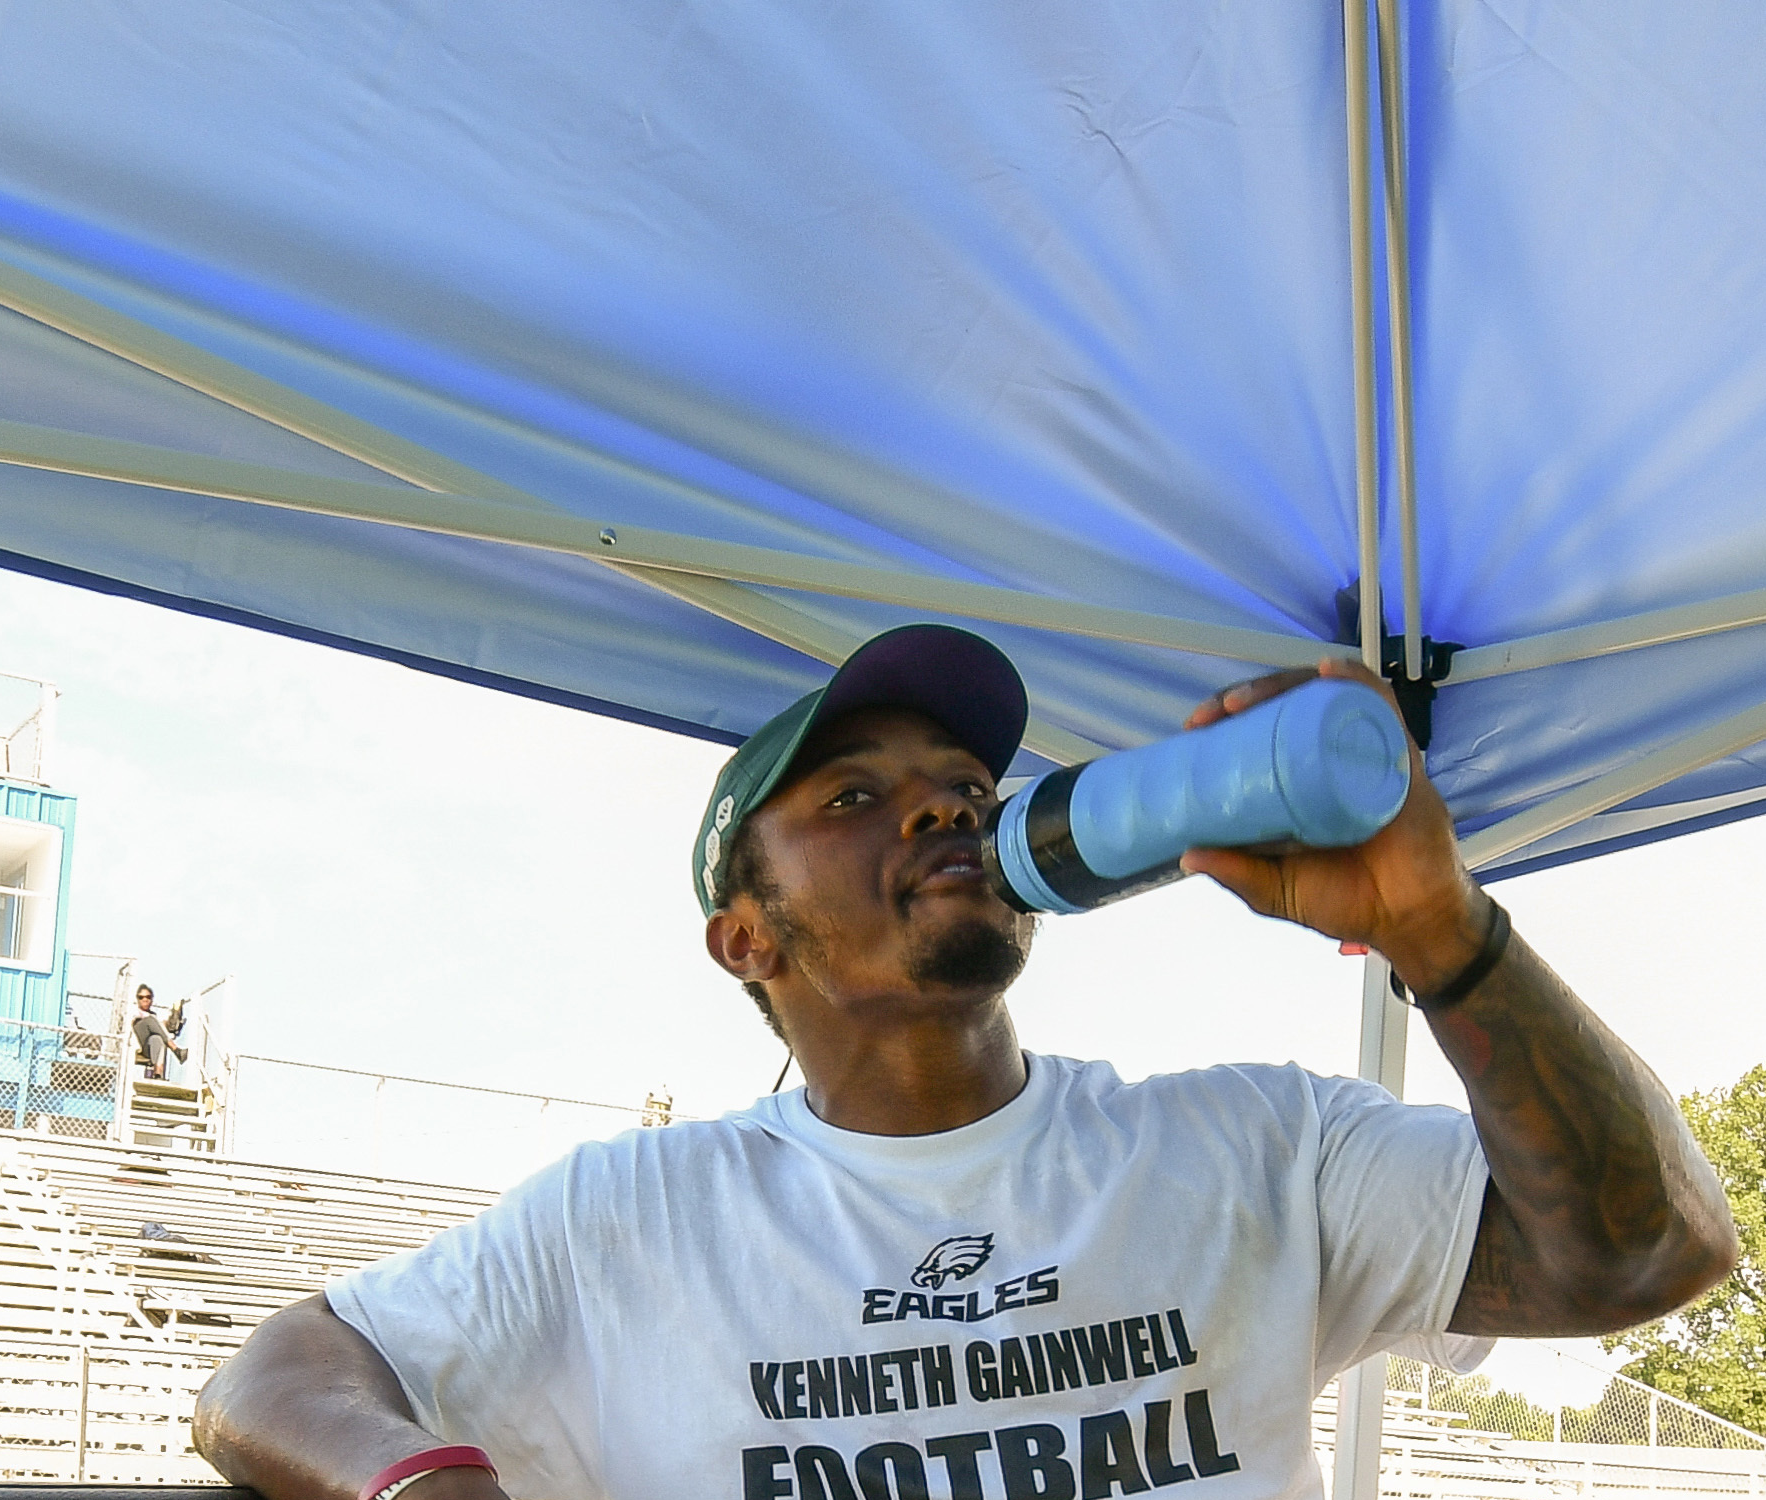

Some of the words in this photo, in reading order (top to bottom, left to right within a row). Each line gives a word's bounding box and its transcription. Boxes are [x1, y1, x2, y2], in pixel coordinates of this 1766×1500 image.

[861, 1264, 1060, 1325] EAGLES
[749, 1344, 956, 1421] KENNETH
[965, 1308, 1199, 1401] GAINWELL
